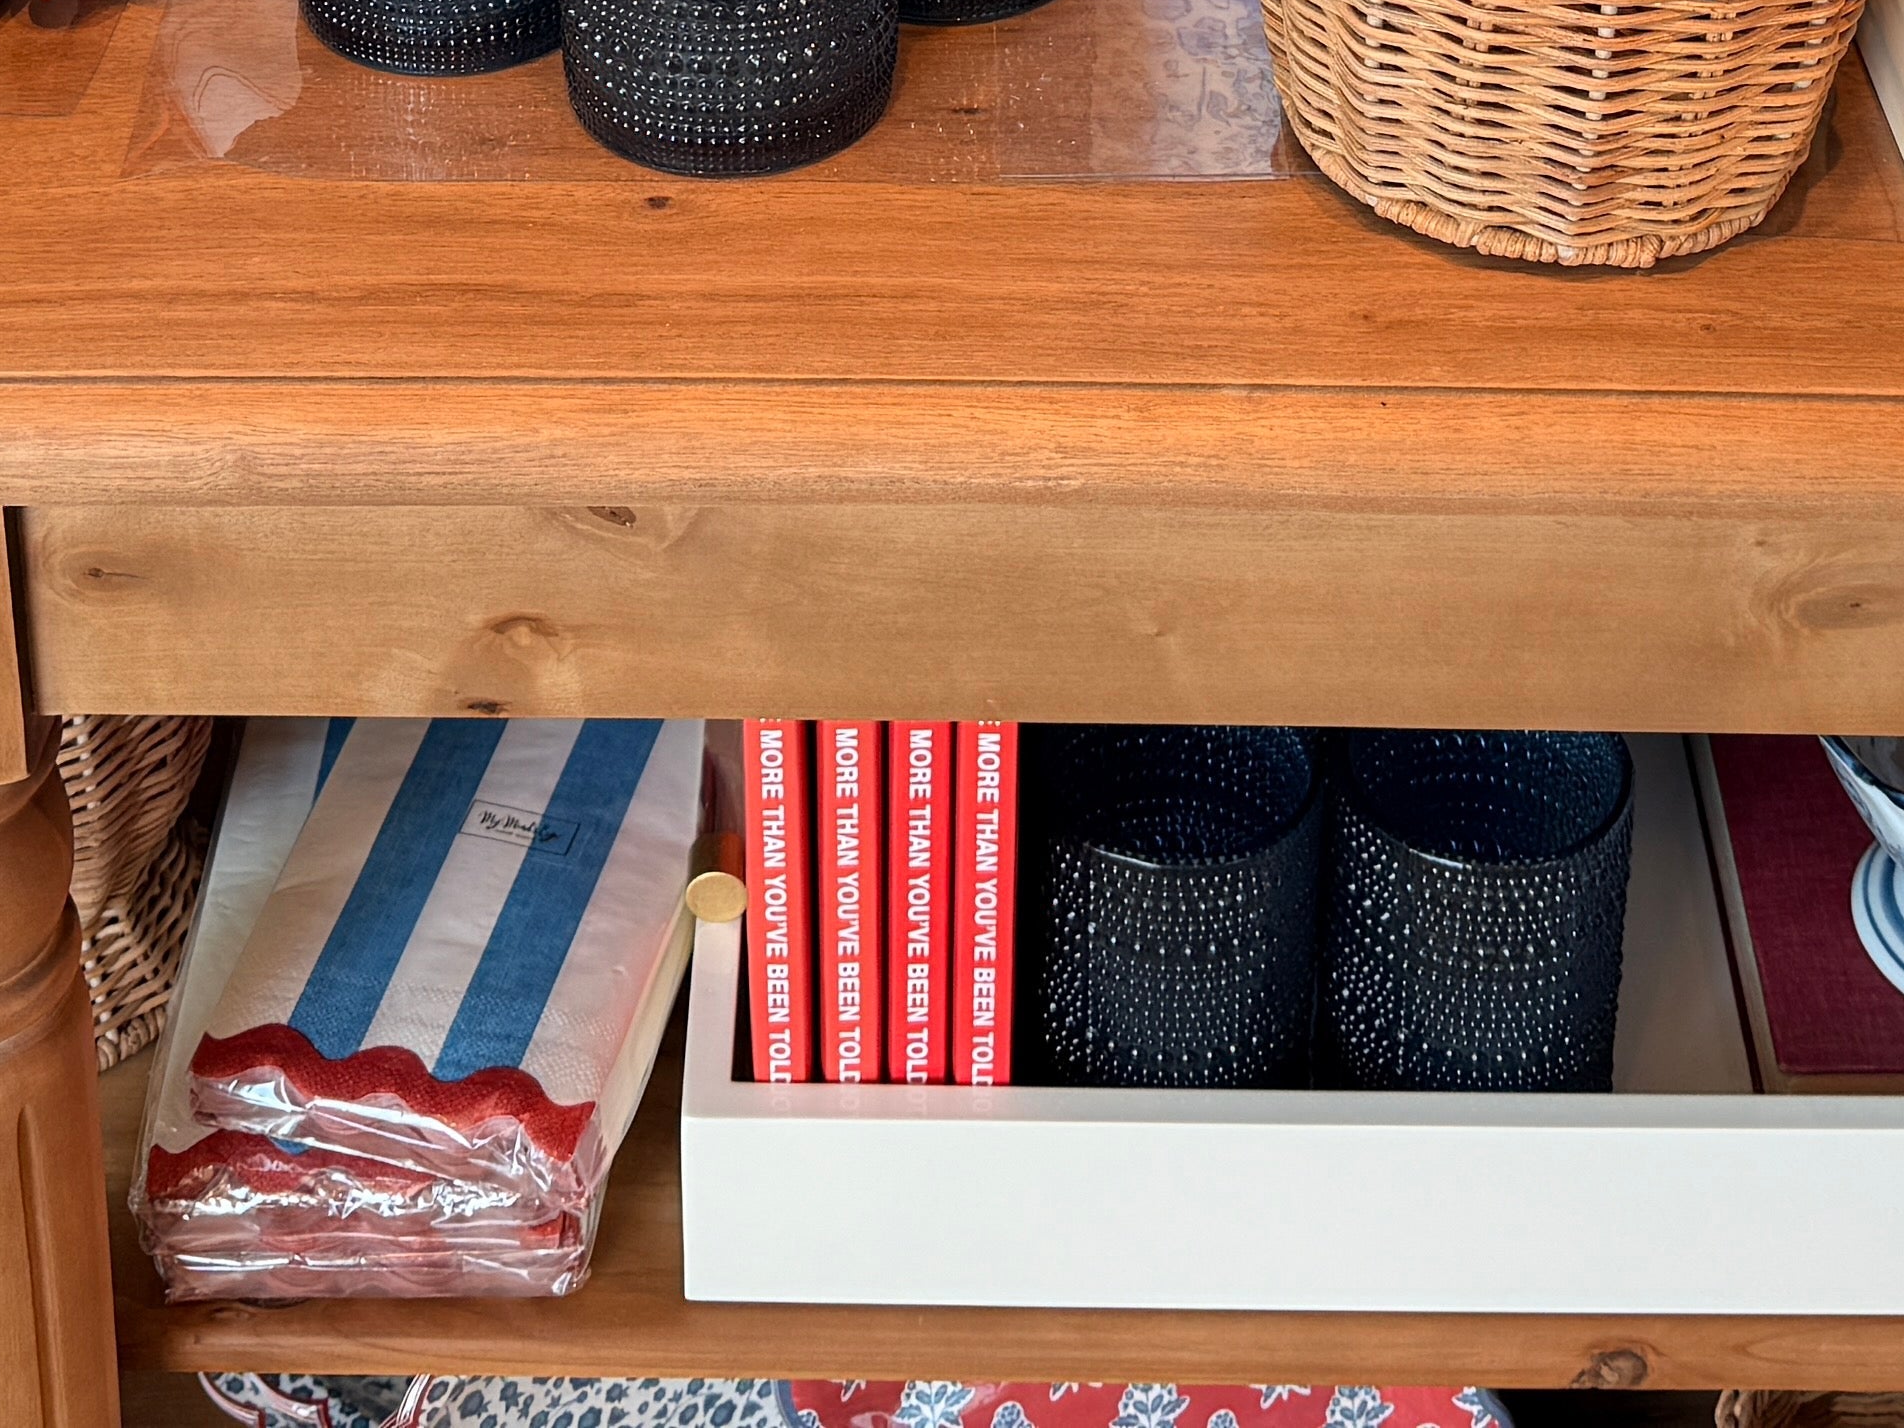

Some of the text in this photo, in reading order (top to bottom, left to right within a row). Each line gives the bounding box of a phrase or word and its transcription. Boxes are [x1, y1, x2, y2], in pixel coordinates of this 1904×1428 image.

[759, 729, 784, 799] MORE
[835, 728, 859, 798] MORE
[909, 729, 933, 799] MORE
[977, 733, 1001, 803] MORE
[762, 804, 786, 868] THAN
[836, 803, 859, 866] THAN
[908, 804, 931, 868] THAN
[975, 808, 999, 872] THAN
[764, 874, 788, 958] YOU'VE
[837, 872, 860, 957] YOU'VE
[907, 873, 930, 958] YOU'VE
[974, 878, 998, 961] YOU'VE
[766, 964, 790, 1023] BEEN
[838, 962, 860, 1022] BEEN
[907, 963, 929, 1023] BEEN
[973, 967, 996, 1027] BEEN
